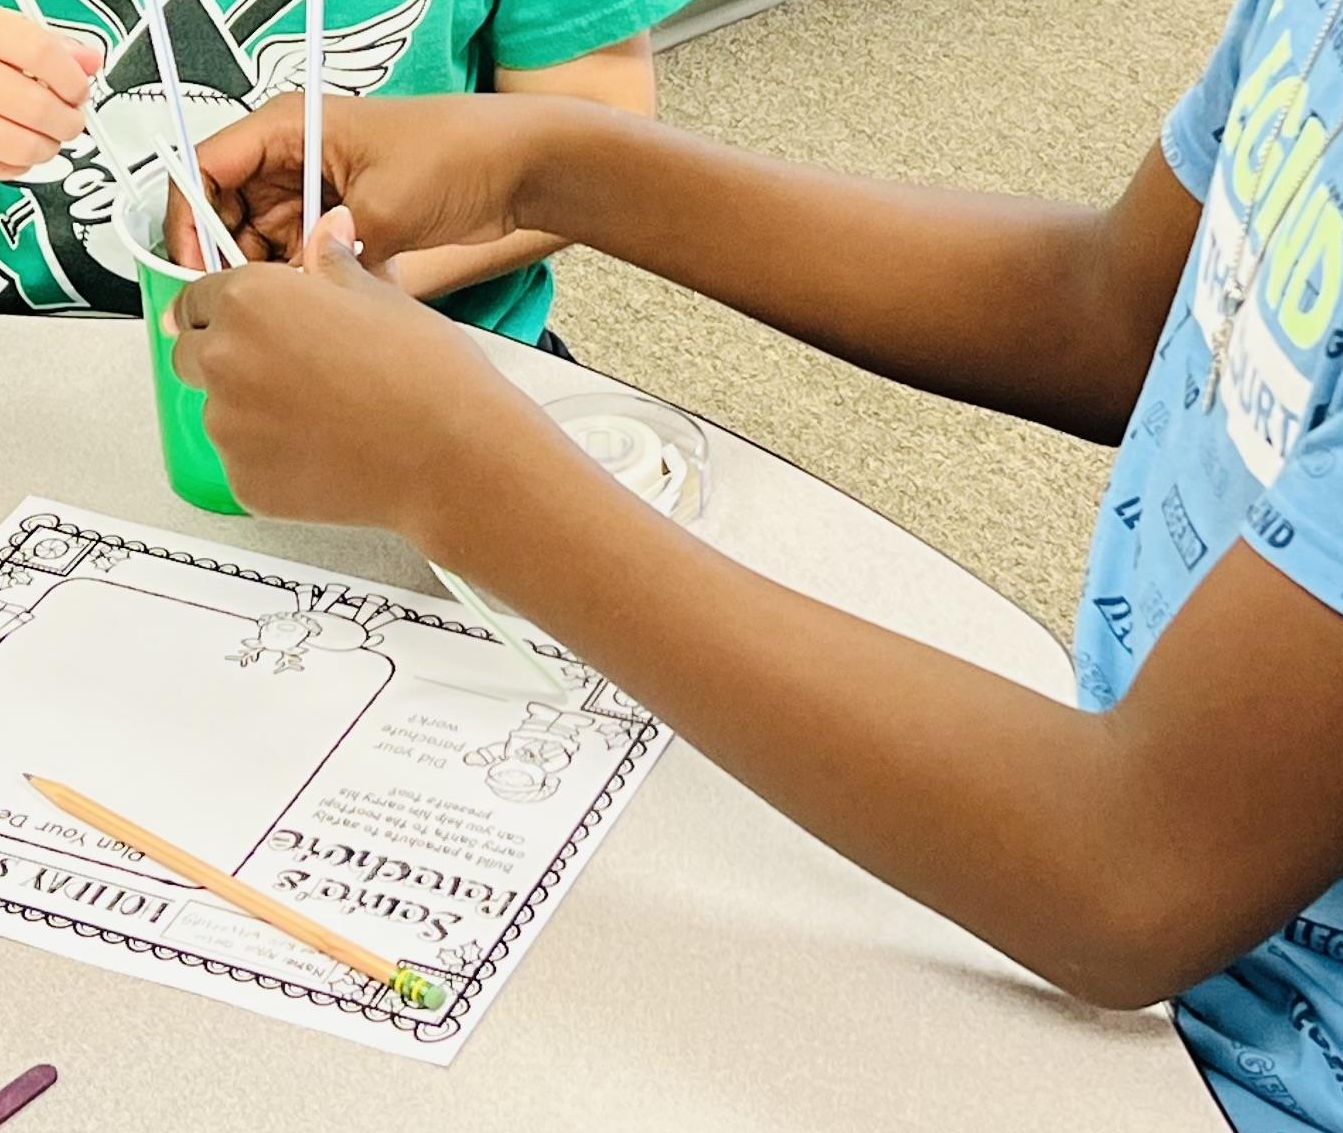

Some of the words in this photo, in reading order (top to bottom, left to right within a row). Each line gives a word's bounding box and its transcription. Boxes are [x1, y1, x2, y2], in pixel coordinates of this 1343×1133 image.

[408, 713, 459, 732] work?
[374, 741, 412, 759] your
[380, 723, 468, 753] parachute
[416, 754, 448, 769] Did
[34, 818, 87, 847] Your
[96, 835, 146, 863] Plan
[268, 829, 518, 918] Parachute
[19, 865, 170, 924] HOLIDAY
[273, 870, 462, 942] Santa's
